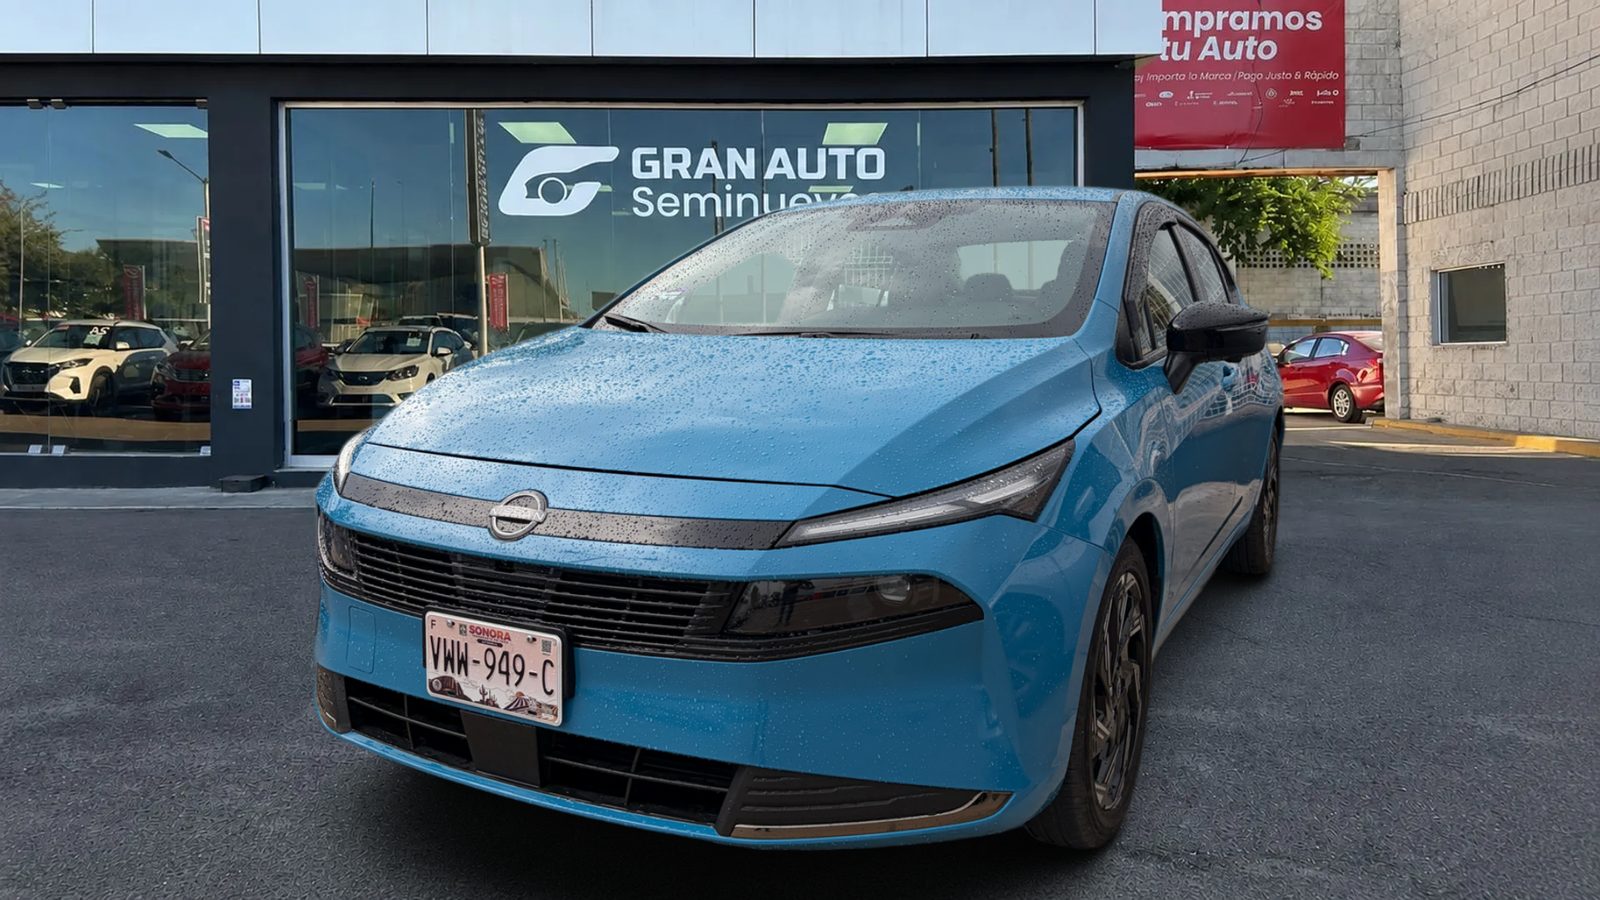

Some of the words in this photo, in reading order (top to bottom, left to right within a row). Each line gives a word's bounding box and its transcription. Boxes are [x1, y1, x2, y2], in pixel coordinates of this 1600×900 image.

[1160, 36, 1191, 61] tu
[1197, 36, 1278, 61] Auto
[1147, 72, 1186, 83] Importa
[1188, 71, 1198, 81] la
[1200, 71, 1232, 81] Marca
[1265, 71, 1293, 80] Justo
[1294, 71, 1302, 80] &
[631, 147, 756, 180] GRAN
[763, 147, 886, 180] AUTO
[430, 619, 437, 630] F
[468, 624, 512, 642] SONORA
[430, 635, 555, 696] VWW-949-C
